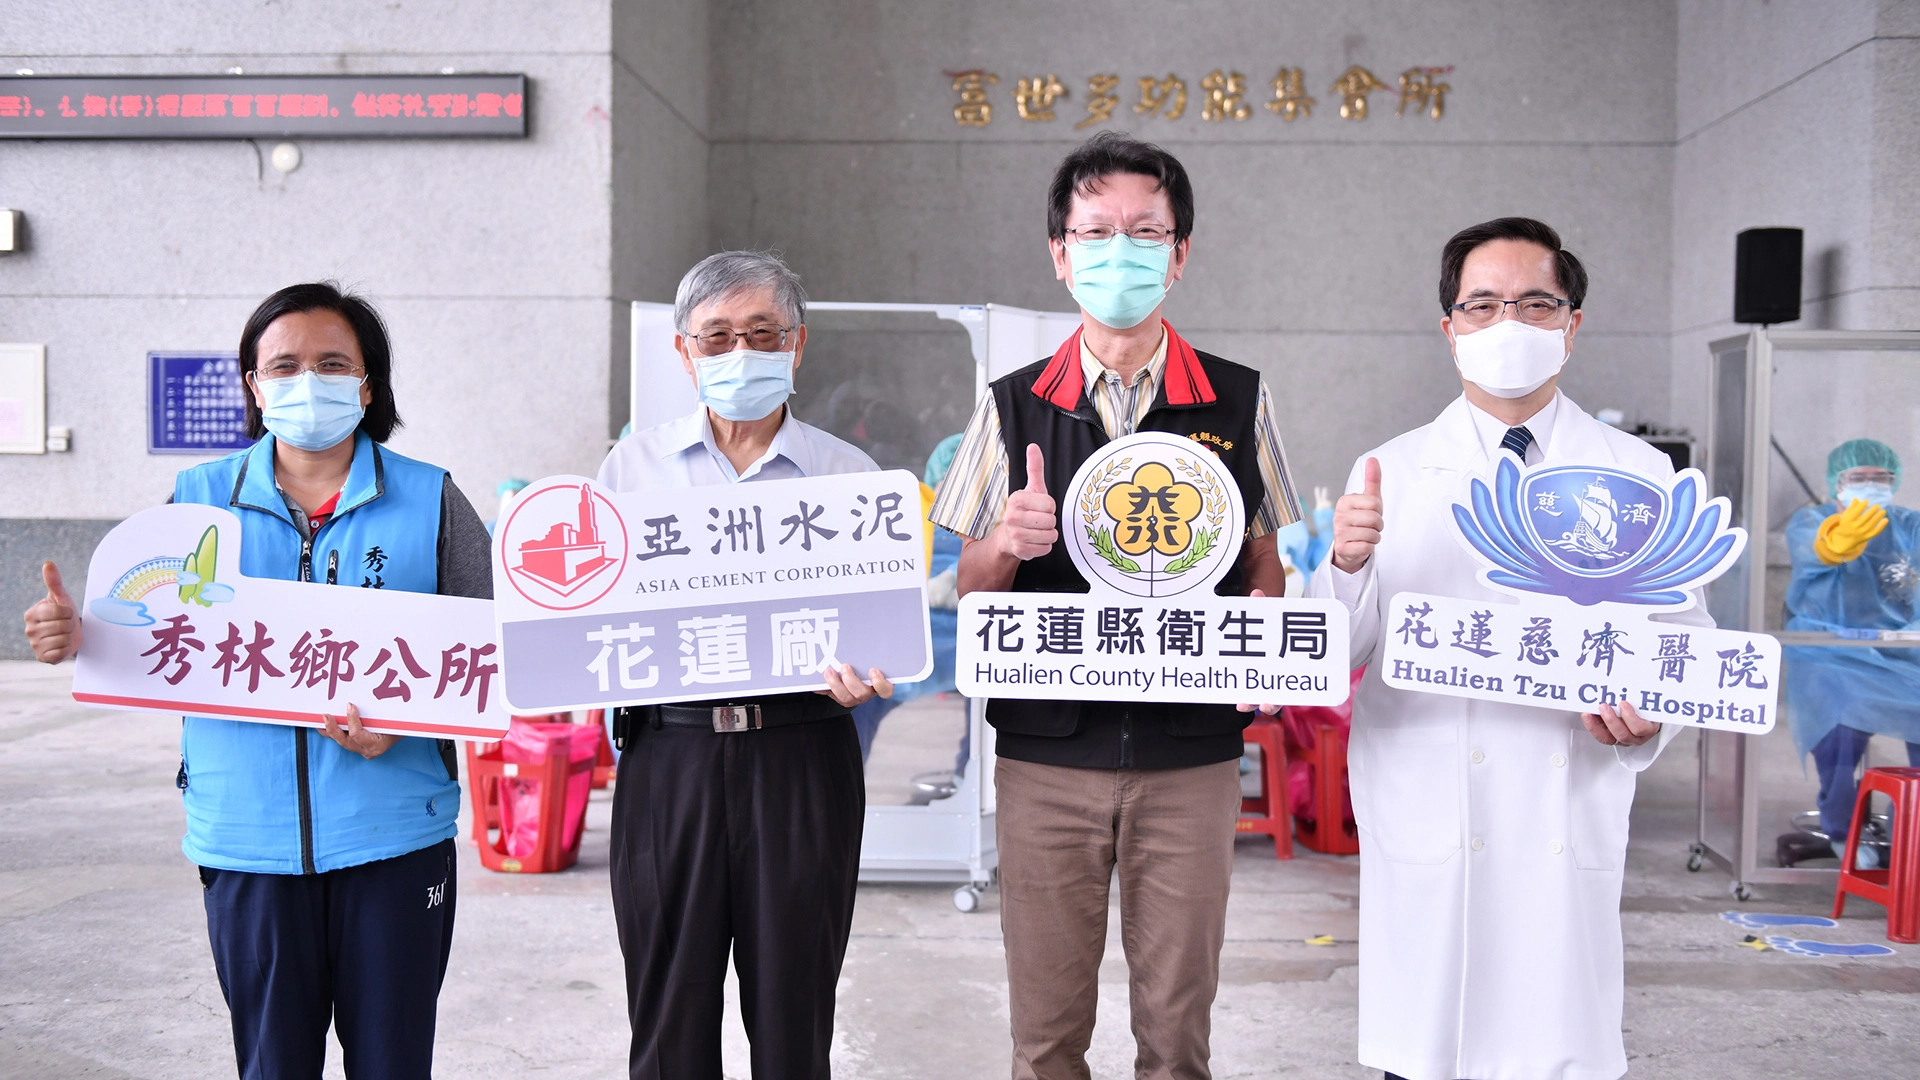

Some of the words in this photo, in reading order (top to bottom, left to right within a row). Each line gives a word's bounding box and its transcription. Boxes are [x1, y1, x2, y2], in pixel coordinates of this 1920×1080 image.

[635, 491, 913, 561] 亞洲水泥
[1533, 491, 1563, 518] 慈
[1620, 502, 1657, 527] 濟
[635, 579, 681, 594] ASIA
[688, 571, 767, 589] CEMENT
[774, 558, 916, 582] CORPORATION
[140, 613, 498, 715] 秀林鄉公所
[586, 608, 843, 692] 花蓮廠
[975, 604, 1329, 661] 花蓮縣衛生局
[1395, 601, 1770, 691] 花蓮慈濟醫院
[975, 662, 1063, 685] Hualien
[1069, 664, 1155, 692] County
[1161, 665, 1238, 690] Health
[1245, 668, 1329, 692] Bureau
[1391, 658, 1504, 693] Hualien
[1513, 673, 1567, 701] Tzu
[1578, 683, 1628, 707] Chi
[1638, 690, 1767, 726] Hospital
